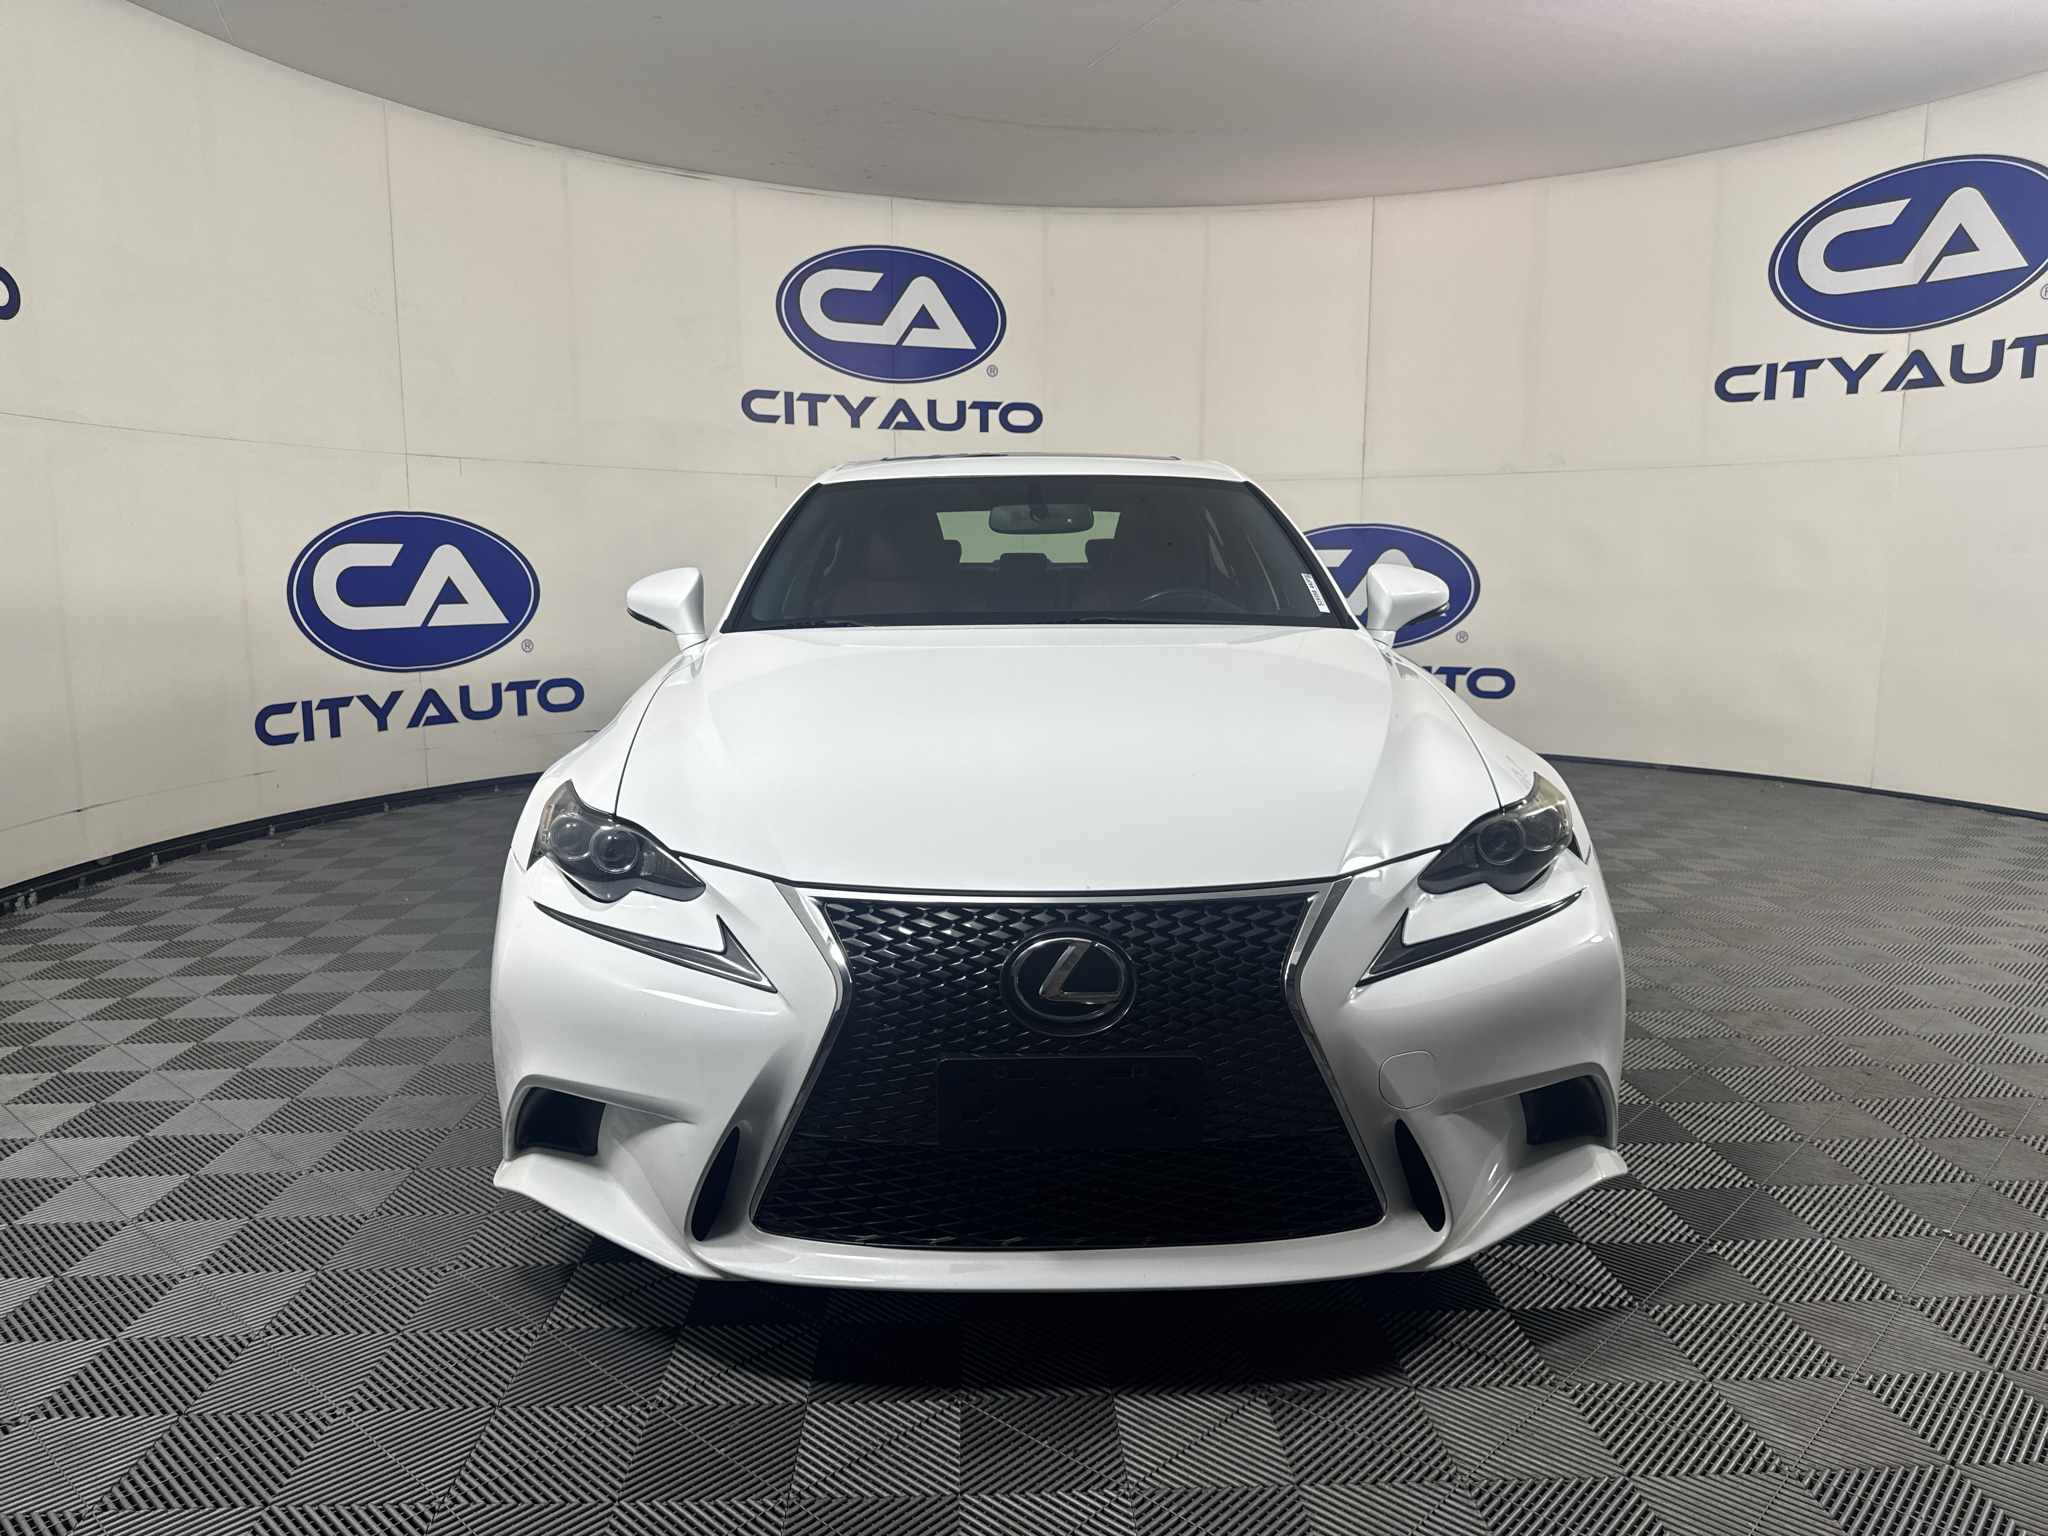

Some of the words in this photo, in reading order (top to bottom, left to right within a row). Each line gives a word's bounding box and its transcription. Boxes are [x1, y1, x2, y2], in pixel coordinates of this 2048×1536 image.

[1797, 186, 2029, 296] CA
[800, 268, 977, 350] CA
[741, 389, 878, 429] CITY
[877, 398, 1043, 434] AUTO
[1714, 353, 1886, 403] CITY
[312, 542, 510, 630] CA
[254, 690, 404, 746] CITY
[406, 677, 585, 729] AUTO
